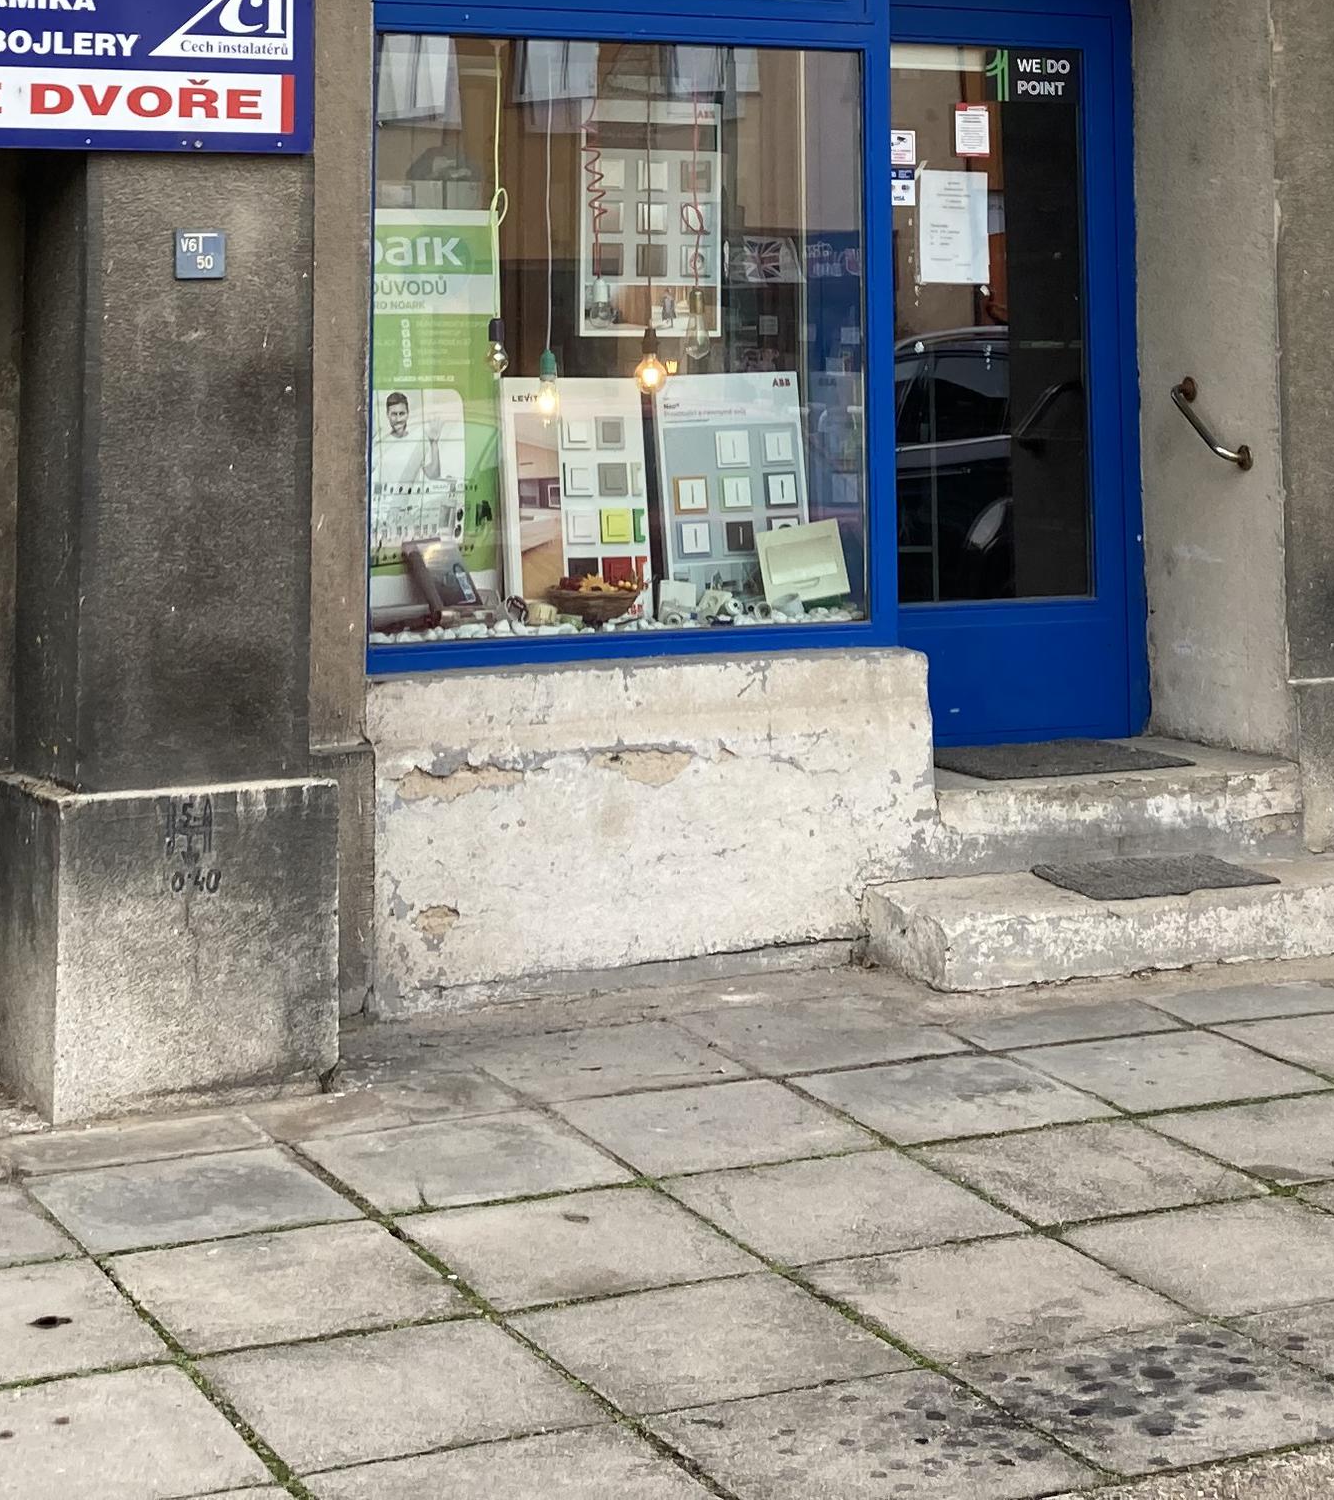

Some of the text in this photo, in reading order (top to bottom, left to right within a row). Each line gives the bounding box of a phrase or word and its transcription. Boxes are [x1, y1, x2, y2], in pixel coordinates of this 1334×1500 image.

[180, 40, 288, 55] Cech instalatérů
[1017, 80, 1065, 96] POINT
[30, 79, 263, 120] DVOŘE
[181, 238, 197, 252] V6
[374, 236, 462, 266] ark
[197, 255, 214, 269] 50
[374, 275, 447, 296] ŮVODŮ
[772, 378, 791, 388] ABB
